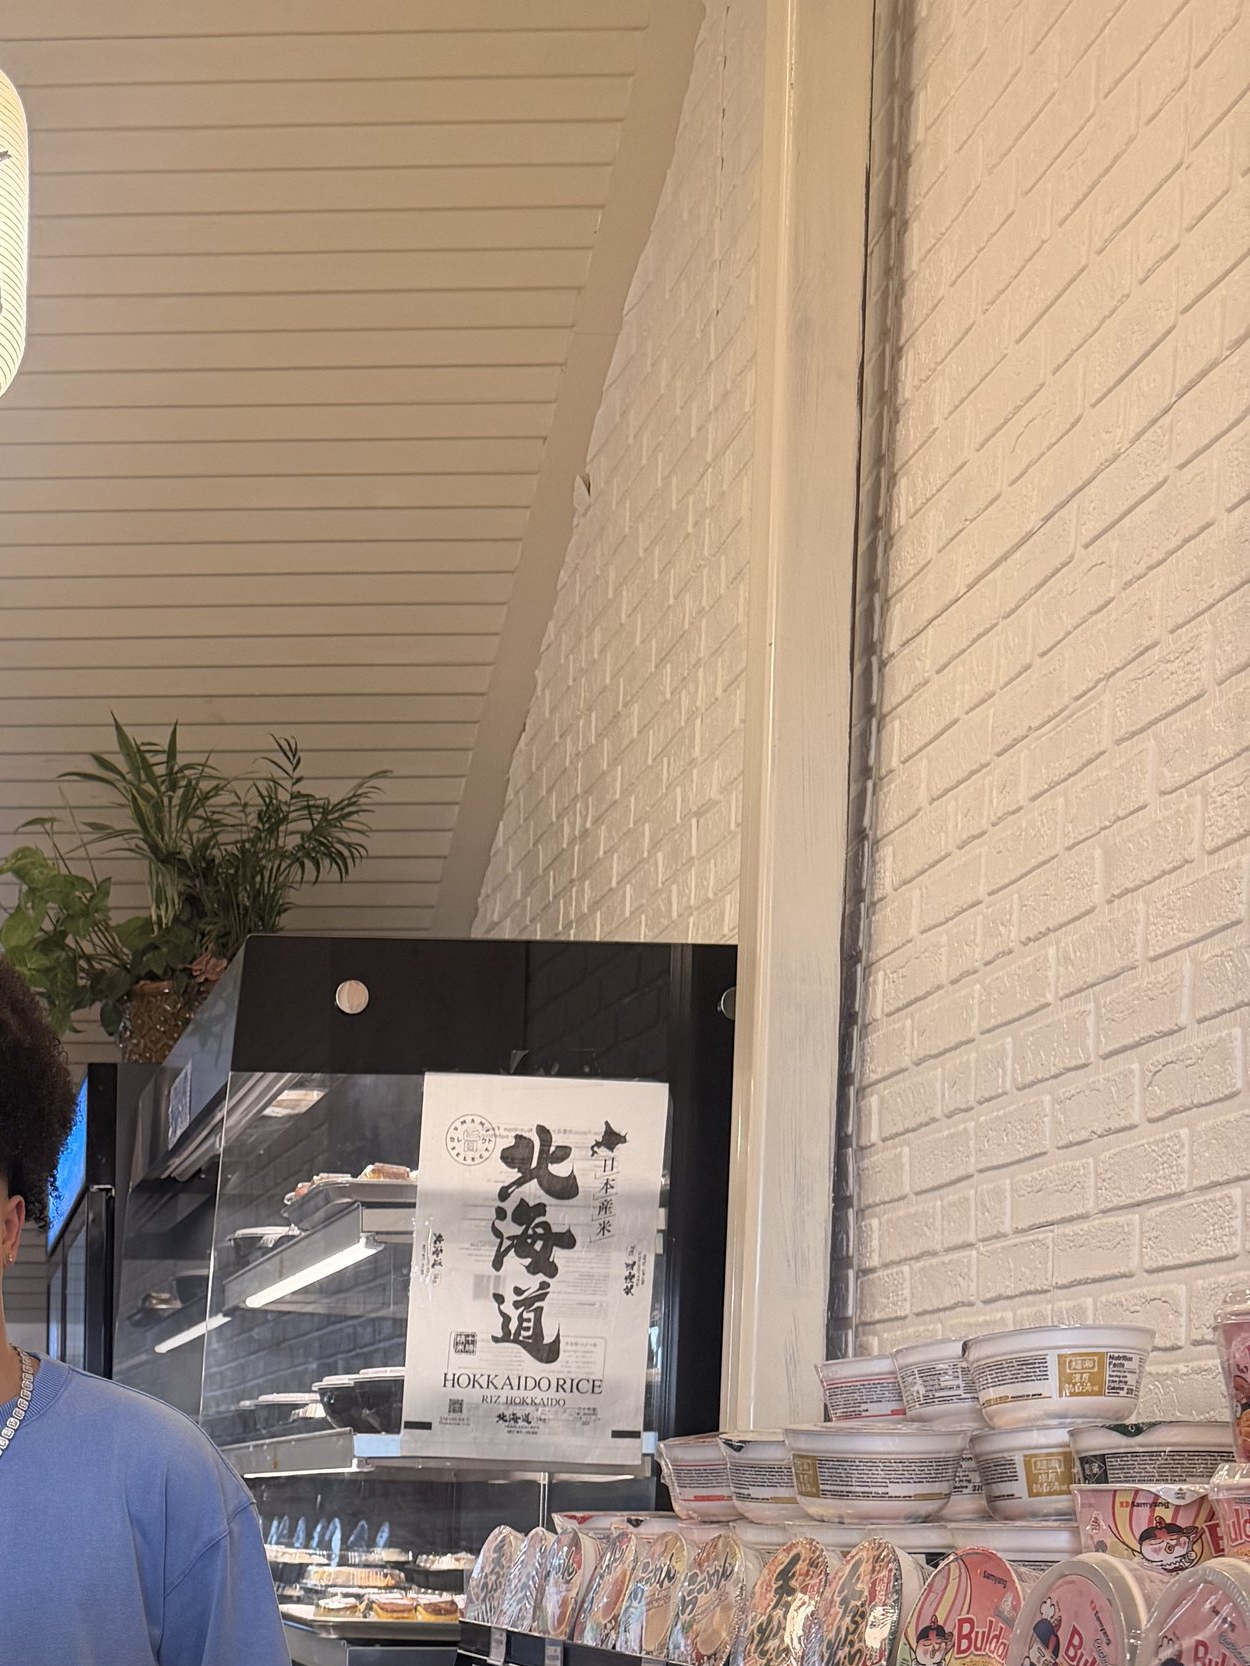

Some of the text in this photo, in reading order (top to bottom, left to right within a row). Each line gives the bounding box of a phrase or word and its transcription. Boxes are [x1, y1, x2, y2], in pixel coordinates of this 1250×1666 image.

[491, 1124, 579, 1364] 北海道
[442, 1372, 604, 1395] HOKKAIDO RICE
[481, 1394, 566, 1408] RIZ HOKKAIDO
[953, 1616, 1009, 1666] Bulda
